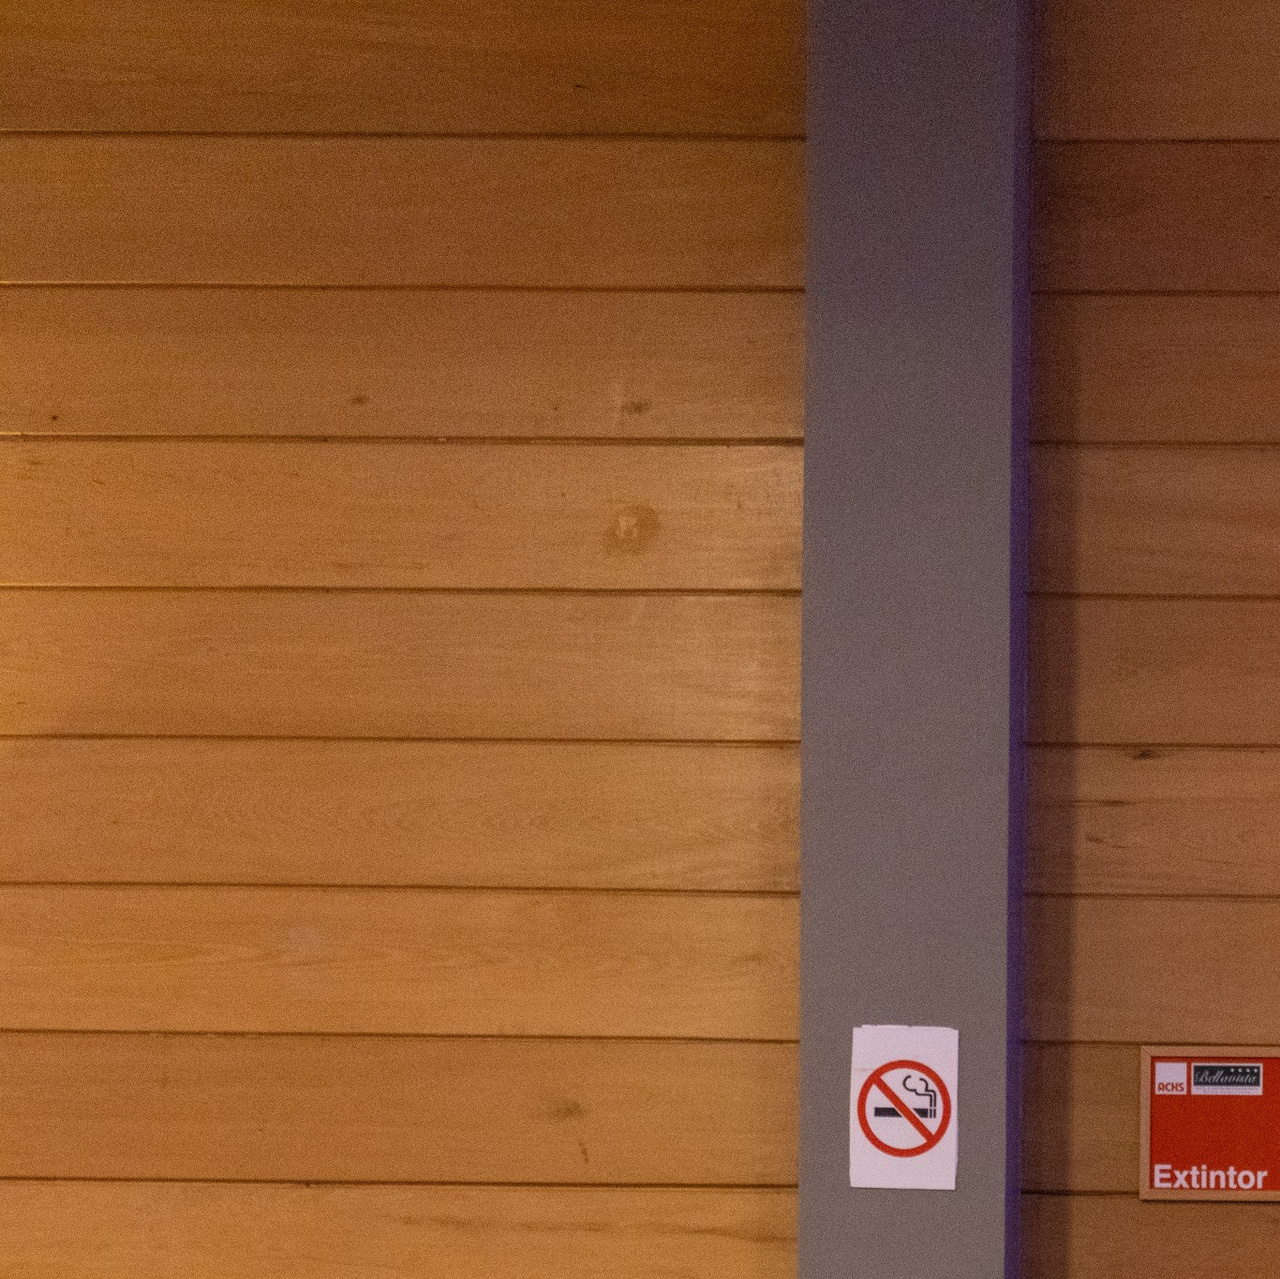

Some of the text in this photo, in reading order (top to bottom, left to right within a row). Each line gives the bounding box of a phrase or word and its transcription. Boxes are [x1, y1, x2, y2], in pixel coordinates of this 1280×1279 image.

[1195, 1070, 1258, 1083] Bellavista
[1157, 1082, 1184, 1093] ACHS
[1153, 1163, 1268, 1190] Extintor
